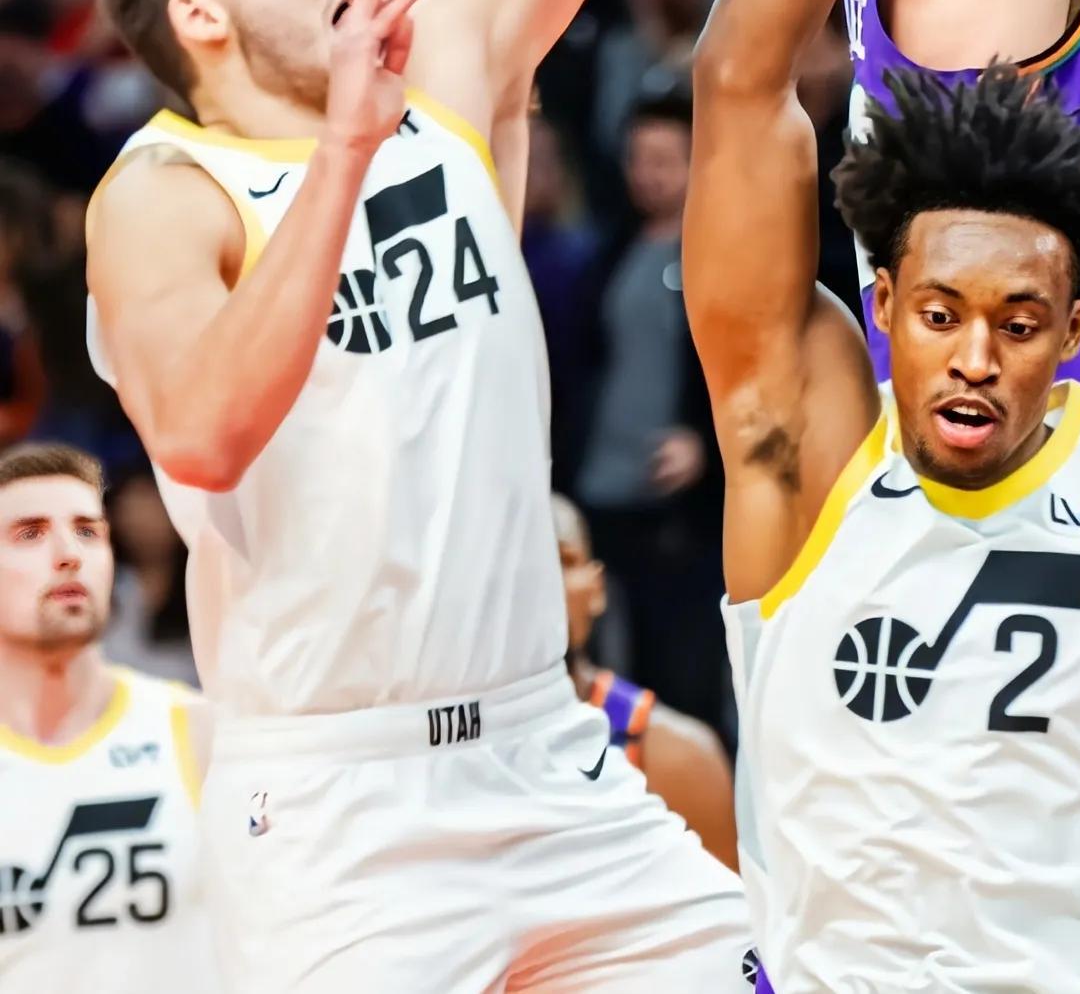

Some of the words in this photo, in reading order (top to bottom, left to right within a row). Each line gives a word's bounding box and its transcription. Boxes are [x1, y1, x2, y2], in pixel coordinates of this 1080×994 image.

[382, 216, 499, 343] 24
[427, 701, 481, 746] UTAH
[987, 612, 1058, 734] 2
[73, 843, 169, 927] 25
